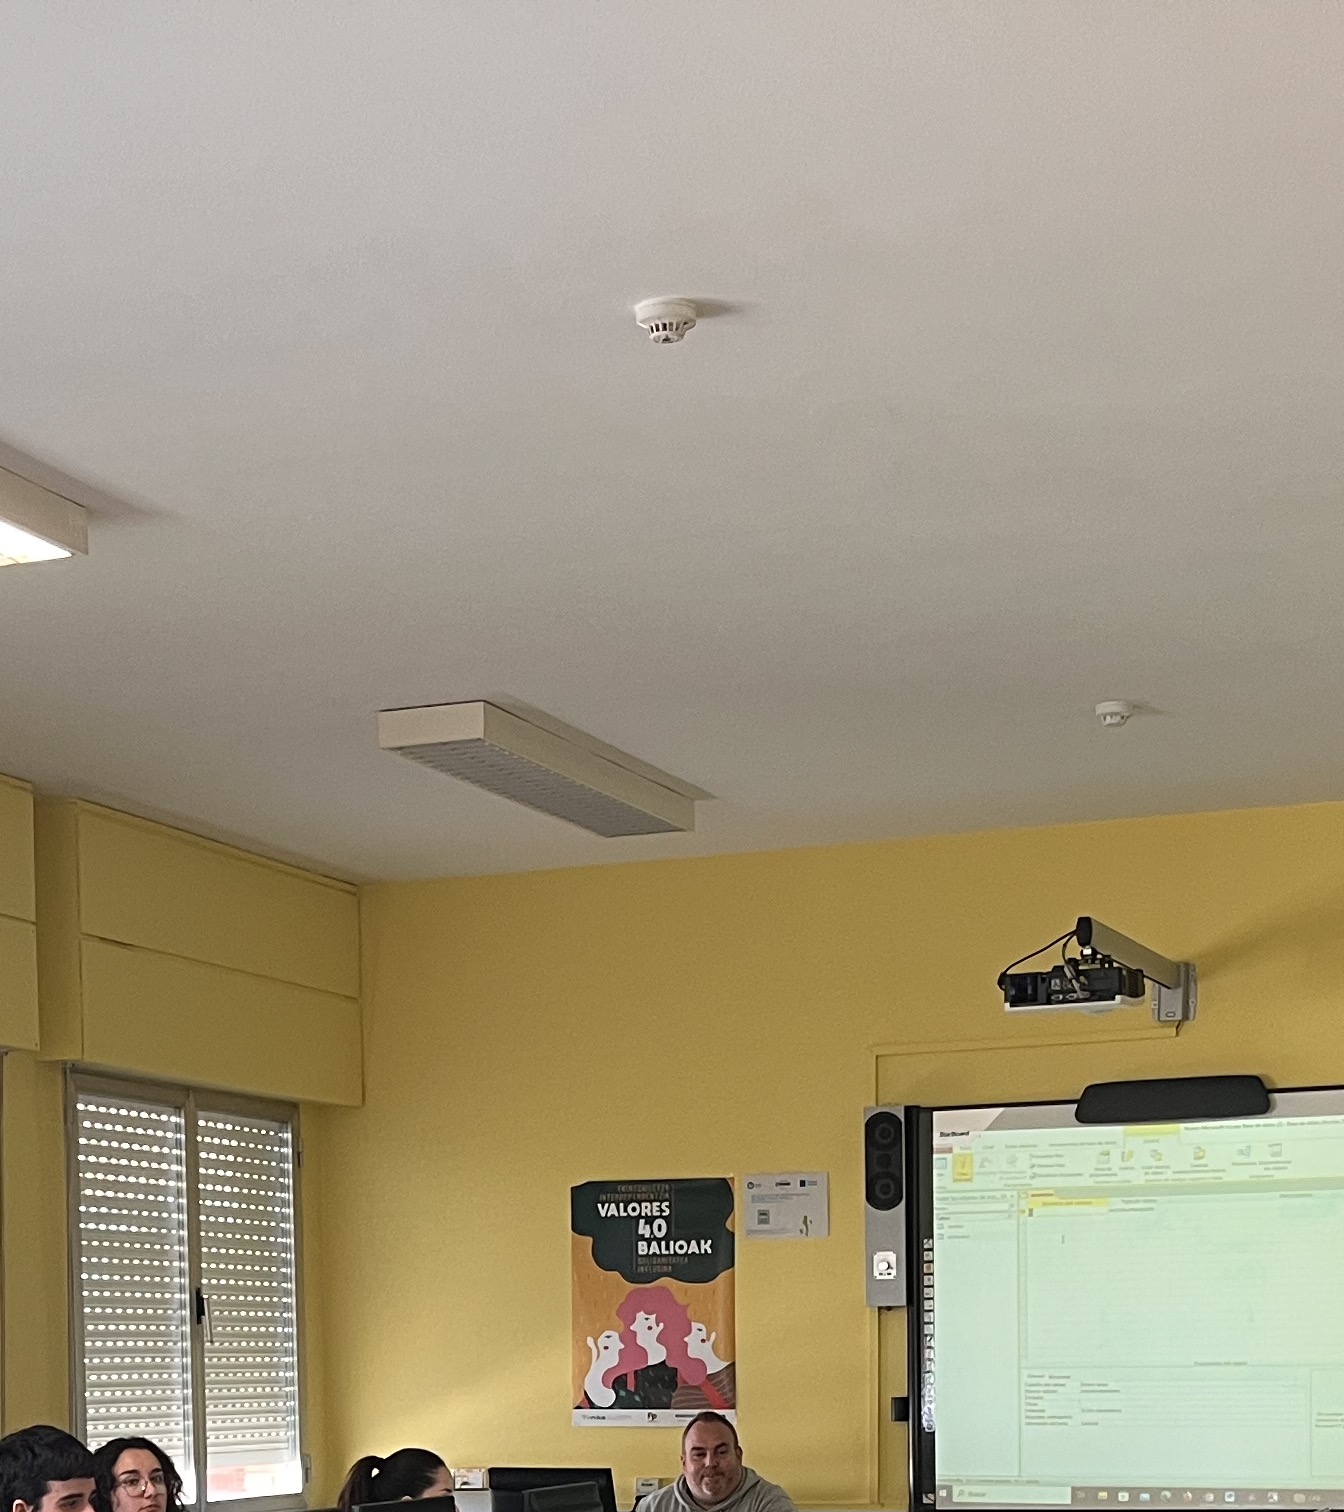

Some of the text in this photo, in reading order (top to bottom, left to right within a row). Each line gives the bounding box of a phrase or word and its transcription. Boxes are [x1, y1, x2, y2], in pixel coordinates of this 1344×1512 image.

[597, 1201, 671, 1217] VALORES
[638, 1218, 668, 1239] 4.0
[637, 1239, 713, 1256] BALIOAK
